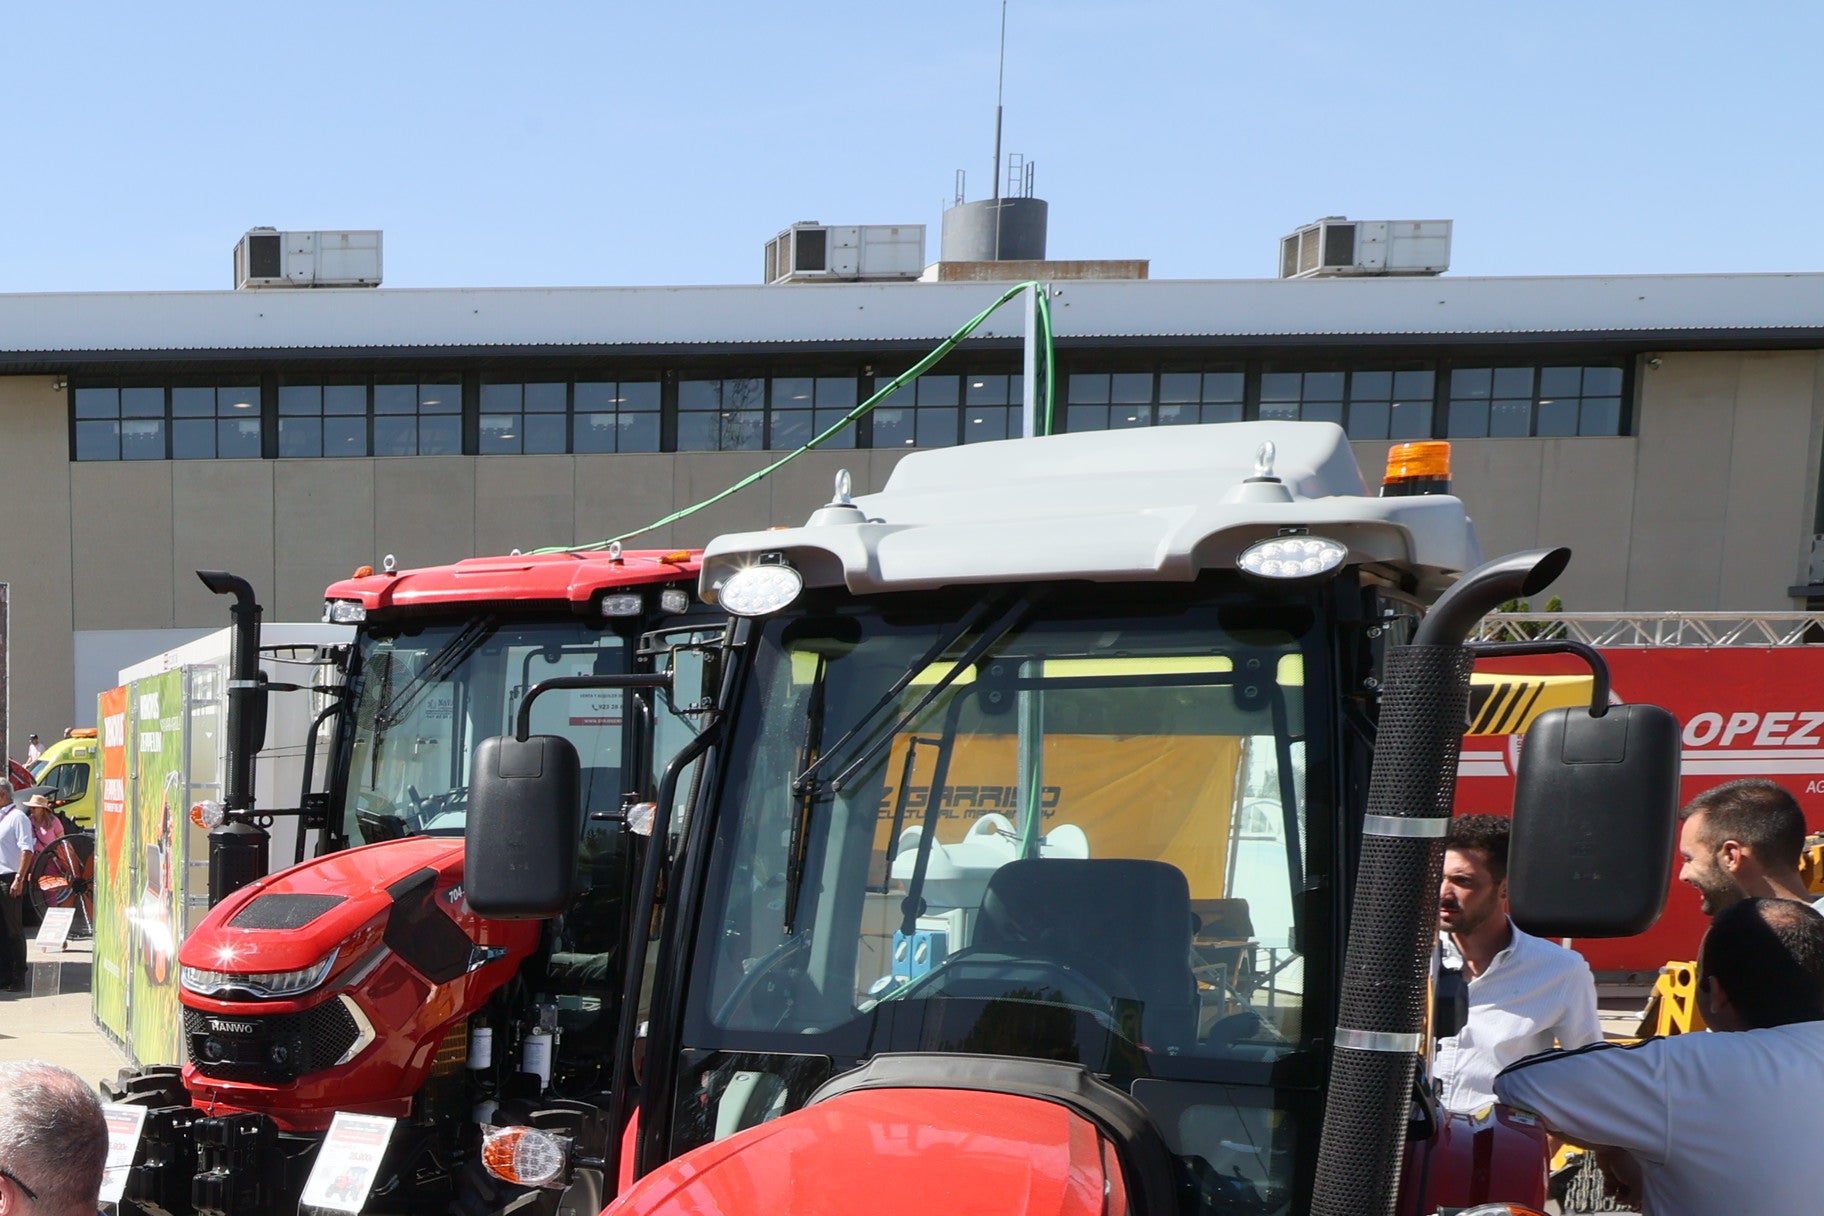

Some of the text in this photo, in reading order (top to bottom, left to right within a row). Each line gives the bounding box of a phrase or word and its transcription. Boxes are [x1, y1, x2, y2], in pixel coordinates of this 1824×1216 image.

[1682, 711, 1824, 747] OPEZ
[906, 786, 1061, 808] GARRIO
[211, 1020, 253, 1034] HANWO
